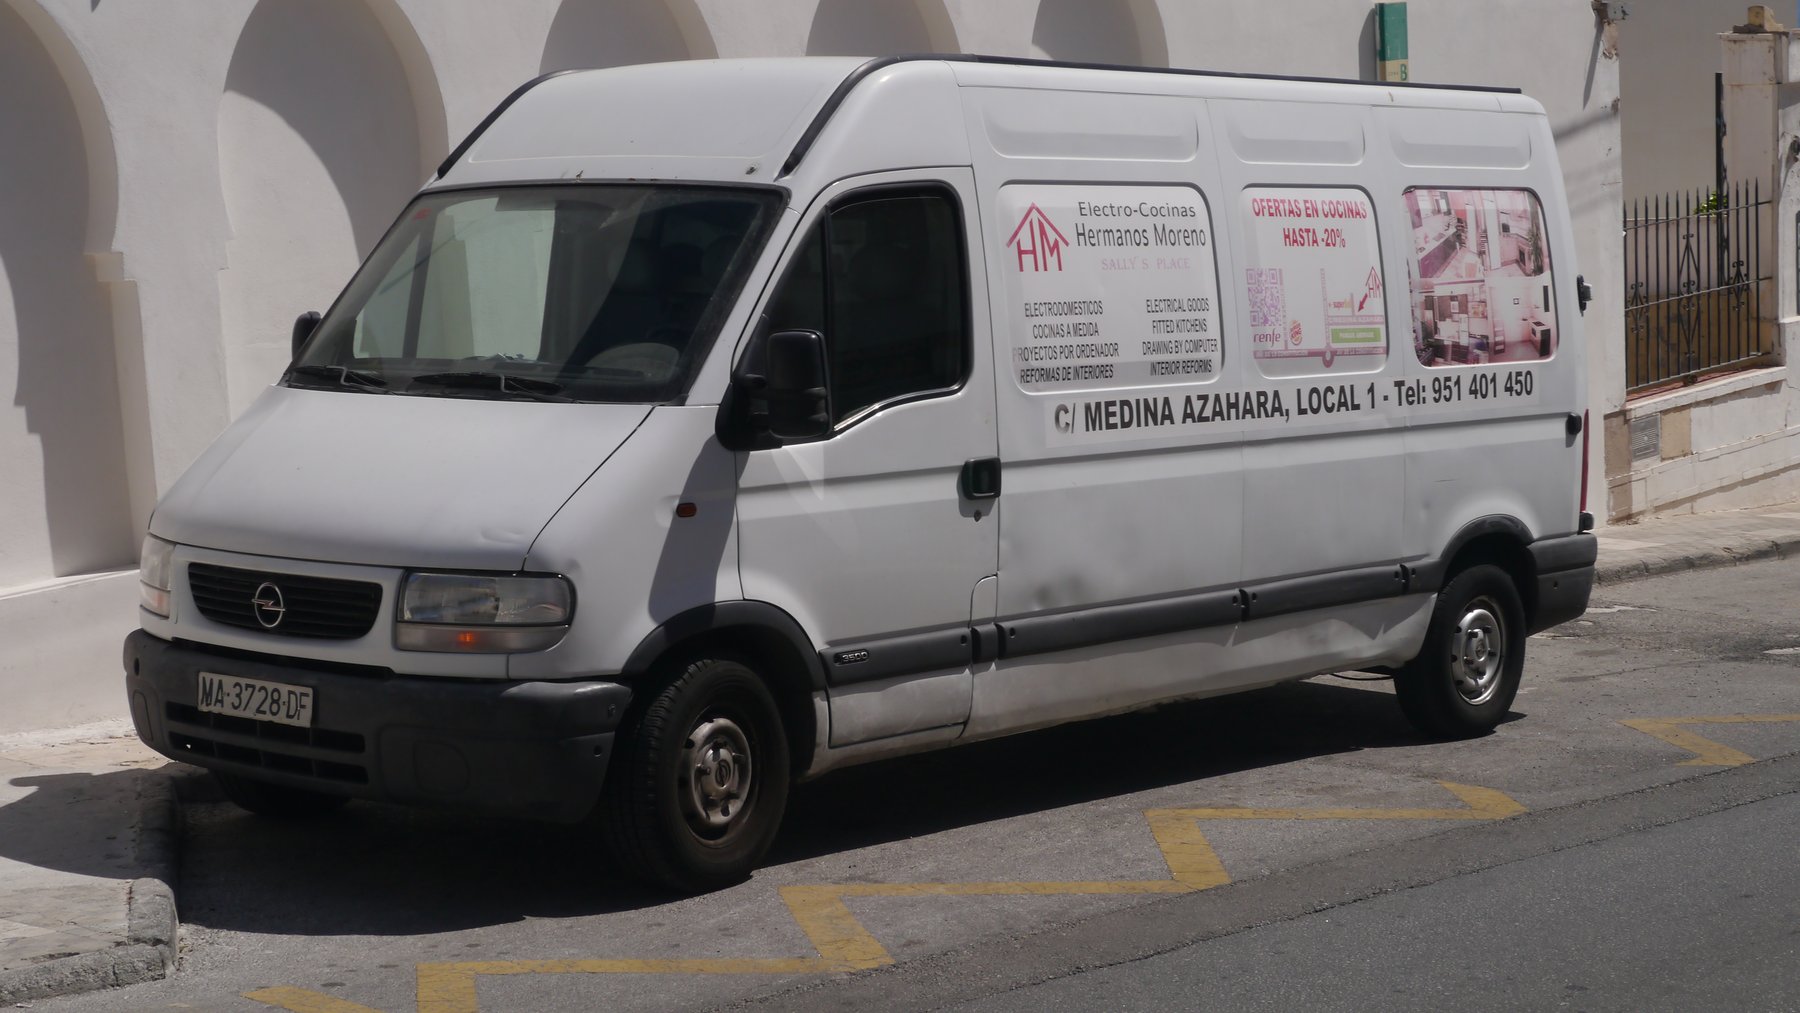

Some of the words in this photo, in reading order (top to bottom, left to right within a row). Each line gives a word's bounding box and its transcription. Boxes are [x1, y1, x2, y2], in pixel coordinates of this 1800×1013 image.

[1078, 201, 1196, 218] Electro-Cocinas
[1252, 197, 1302, 218] OFERTAS
[1303, 199, 1320, 218] EN
[1321, 199, 1368, 219] COCINAS
[1075, 222, 1150, 247] Hermanos
[1153, 223, 1206, 247] Moreno
[1282, 227, 1319, 247] HASTA
[1321, 228, 1346, 248] -20%
[1156, 257, 1190, 270] PLACE
[1024, 300, 1104, 318] ELECTRODOMESTICOS
[1146, 298, 1187, 314] ELECTRICAL
[1187, 297, 1210, 313] GOODS
[1032, 322, 1065, 340] COCINAS
[1066, 322, 1072, 338] A
[1072, 321, 1100, 338] MEDIDA
[1152, 319, 1175, 334] FITTED
[1176, 318, 1208, 333] KITCHENS
[1142, 340, 1173, 356] DRAWING
[1174, 339, 1184, 355] BY
[1184, 338, 1219, 354] COMPUTER
[1252, 328, 1281, 348] renfe
[1059, 343, 1074, 360] POR
[1075, 342, 1119, 359] ORDENADOR
[1020, 366, 1061, 384] REFORMAS
[1061, 366, 1072, 381] DE
[1072, 363, 1115, 381] INTERIORES
[1149, 360, 1181, 377] INTERIOR
[1181, 359, 1213, 375] REFORMS
[1054, 402, 1077, 435] C/
[1084, 396, 1176, 433] MEDINA
[1181, 388, 1291, 425] AZAHARA,
[1296, 383, 1361, 416] LOCAL
[1367, 381, 1376, 409] 1
[1393, 378, 1427, 407] Tel:
[1431, 374, 1462, 403] 951
[1468, 371, 1498, 400] 401
[1503, 369, 1534, 397] 450
[842, 651, 868, 661] 3500
